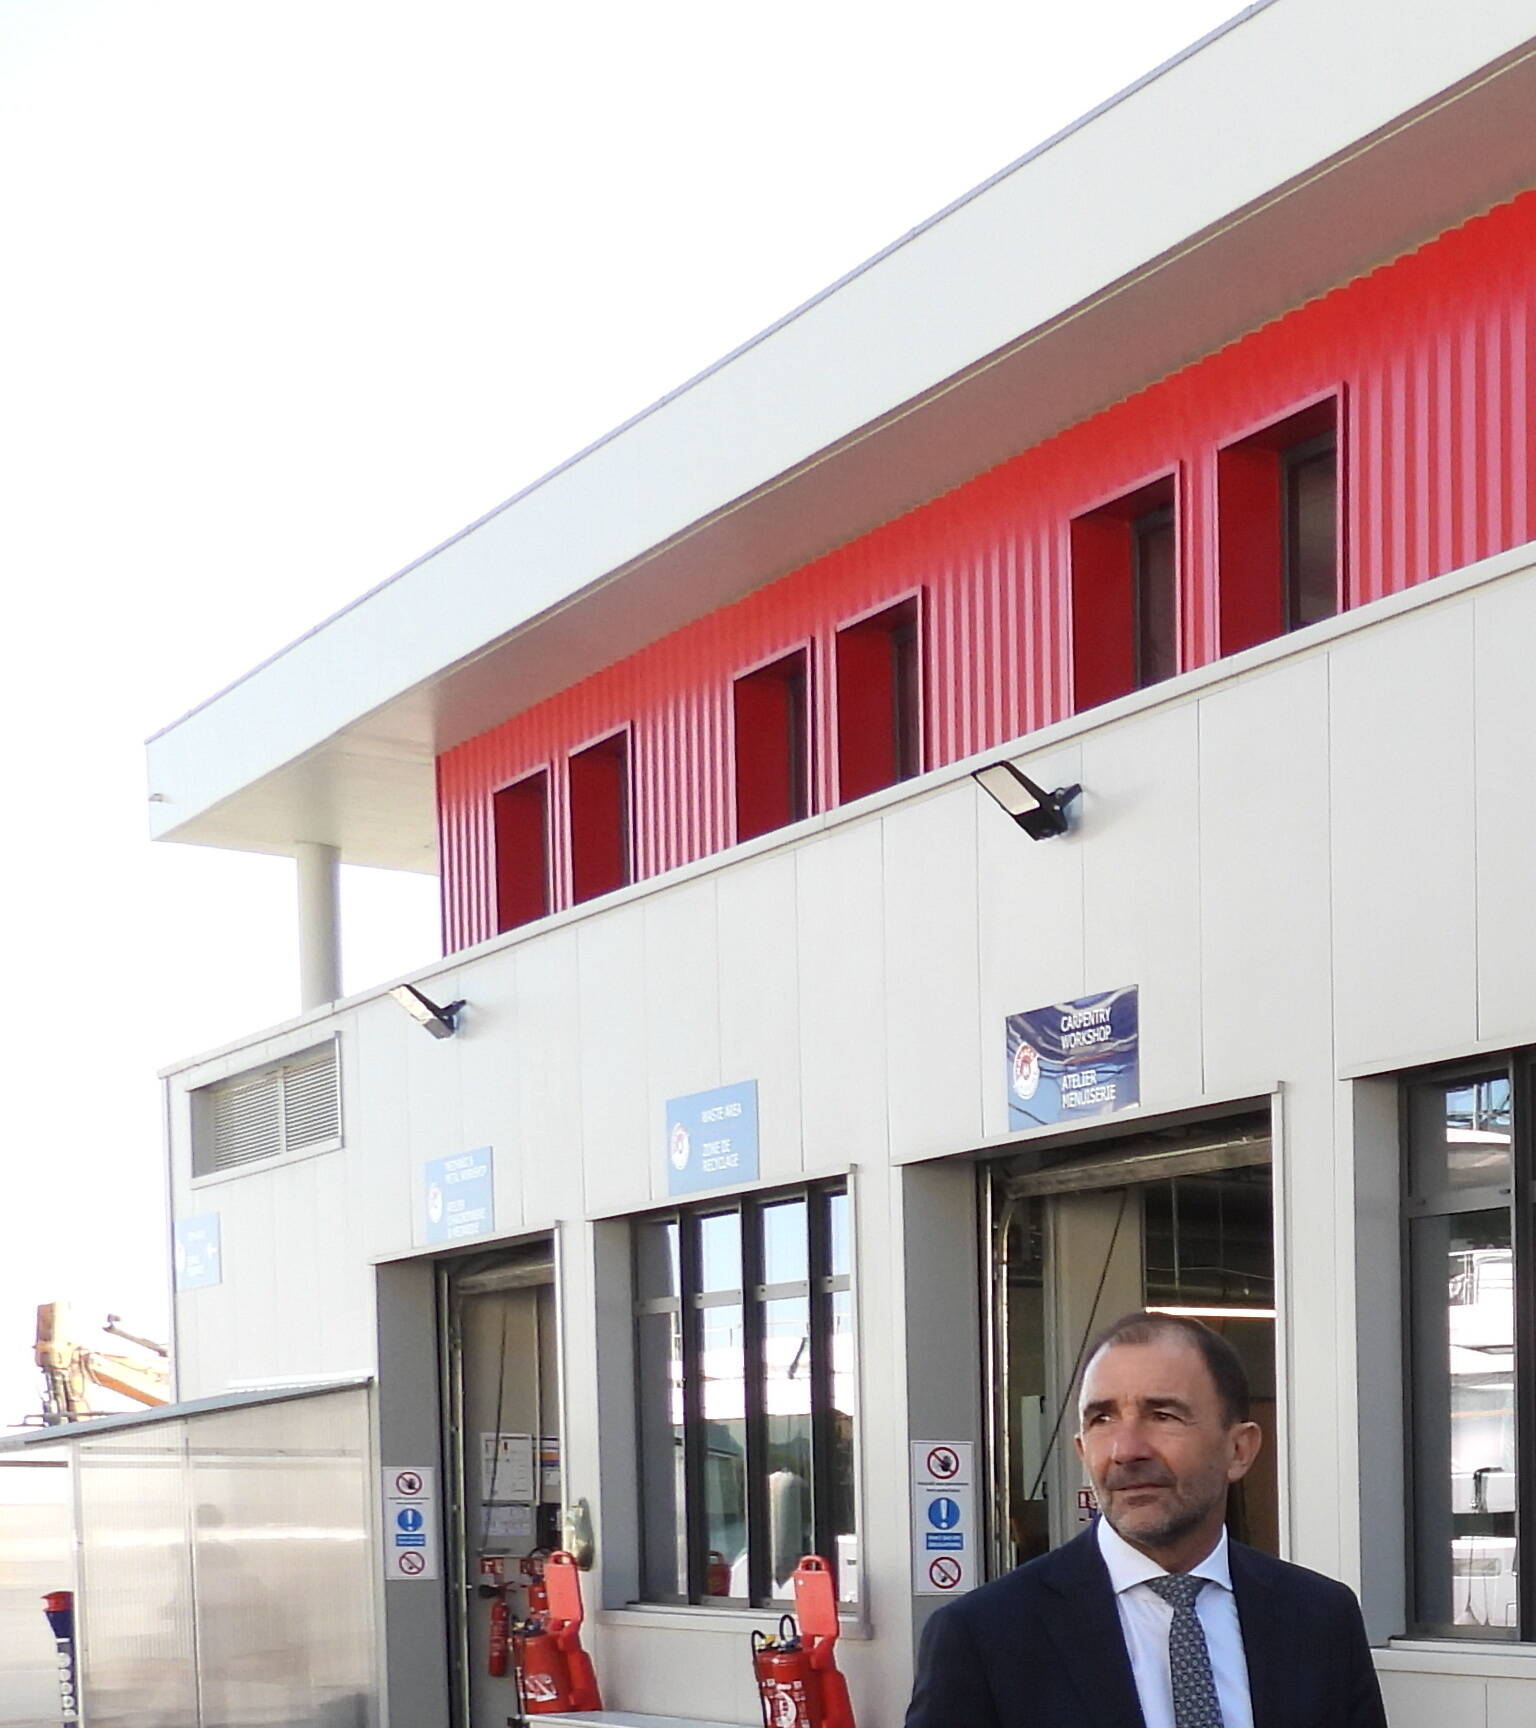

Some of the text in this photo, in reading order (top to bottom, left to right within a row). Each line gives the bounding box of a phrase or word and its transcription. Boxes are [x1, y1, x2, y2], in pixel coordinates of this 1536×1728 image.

[1060, 1007, 1112, 1031] CARPENTRY
[1060, 1025, 1112, 1050] WORKSHOP
[1061, 1070, 1098, 1091] ATELIER
